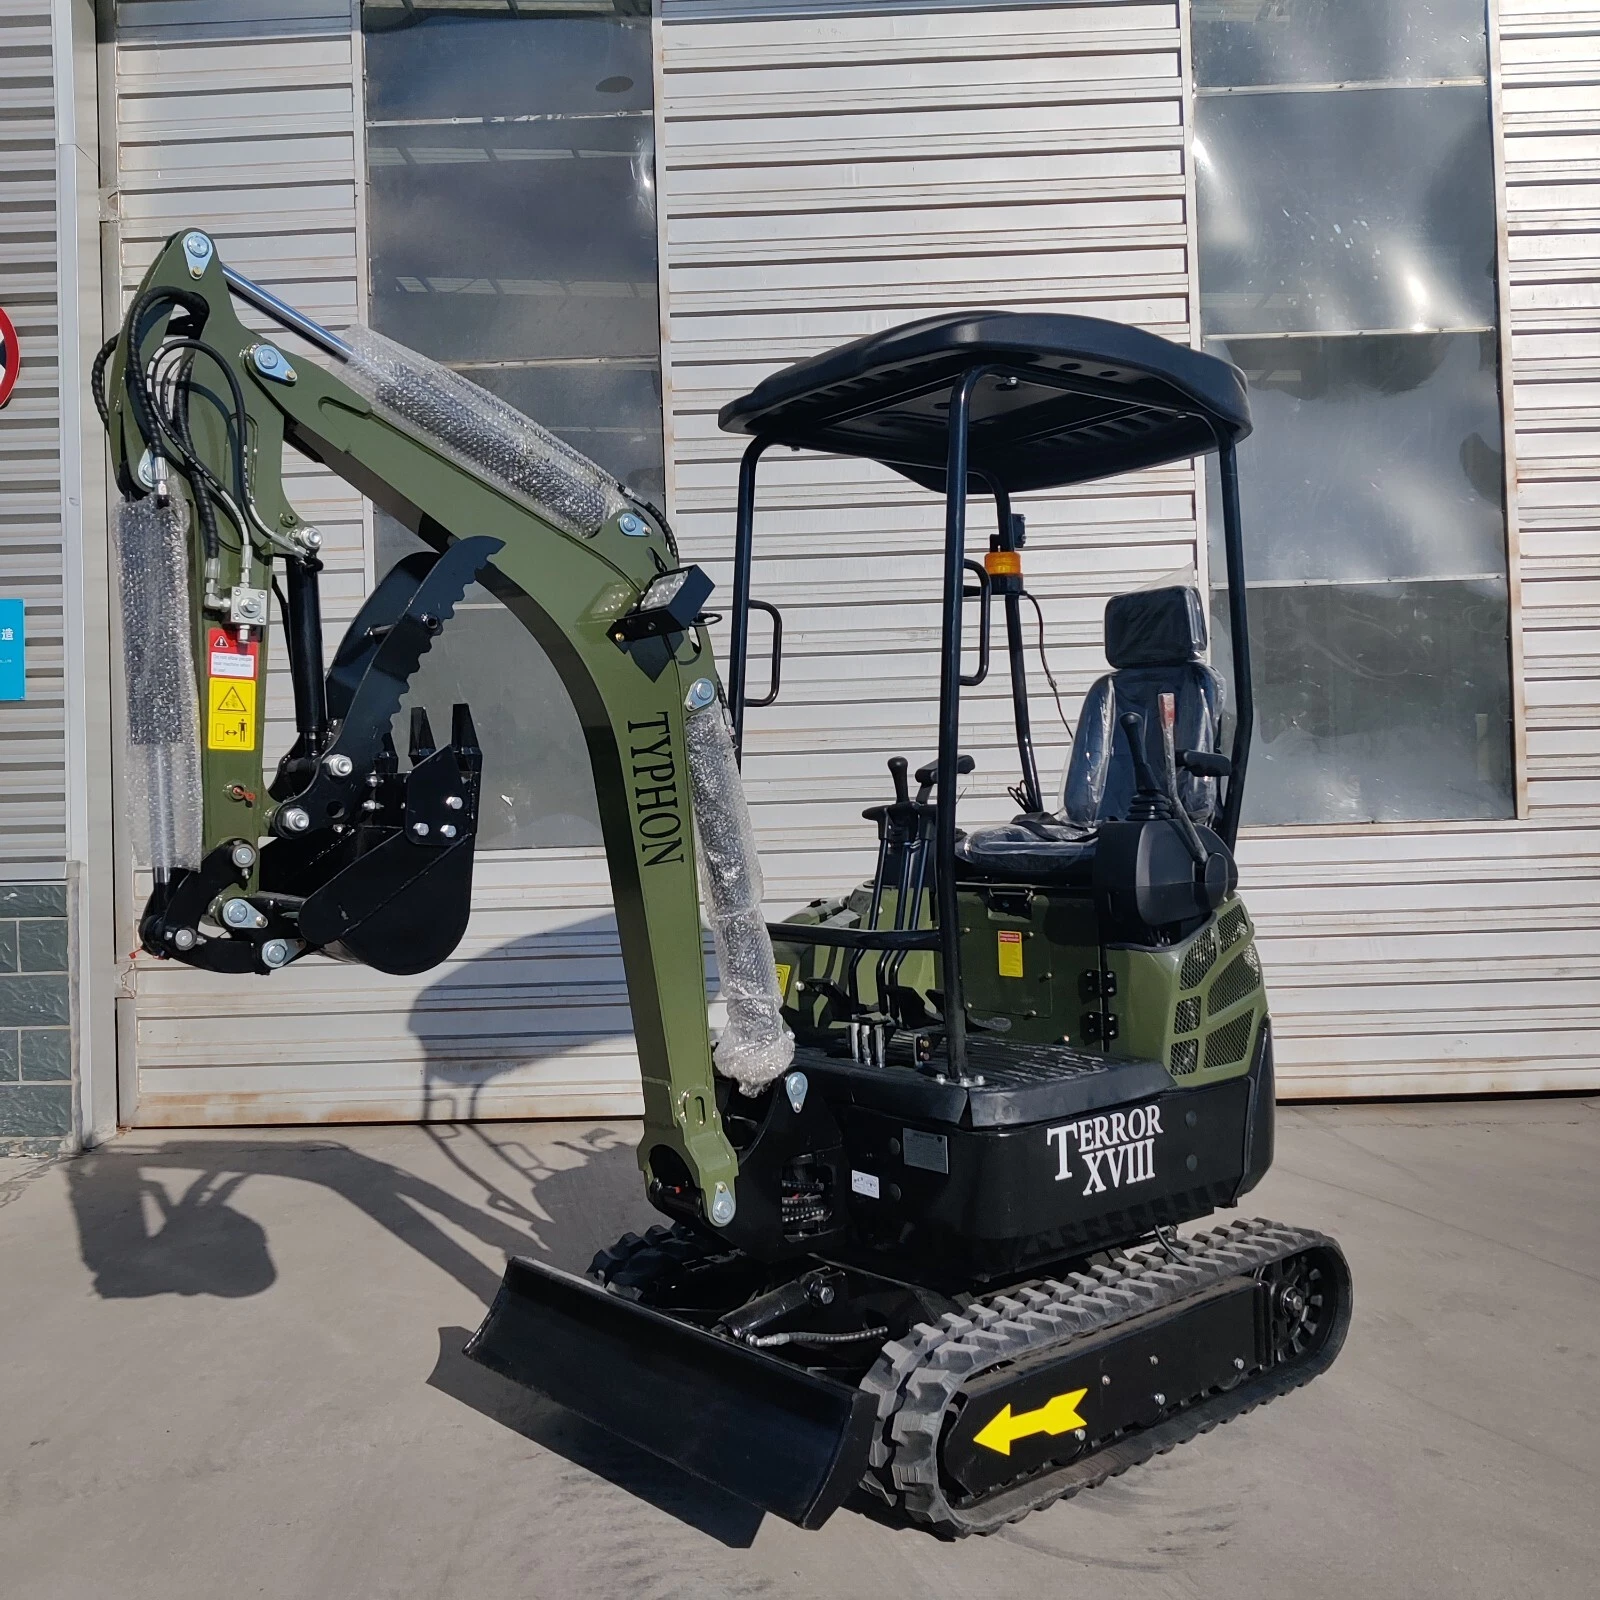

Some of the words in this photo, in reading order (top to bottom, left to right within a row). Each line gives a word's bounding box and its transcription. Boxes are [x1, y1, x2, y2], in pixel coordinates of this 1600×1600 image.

[1, 627, 14, 641] 造
[627, 711, 684, 867] TYPHON
[1046, 1104, 1164, 1181] TERROR
[1082, 1138, 1156, 1196] XVIII
